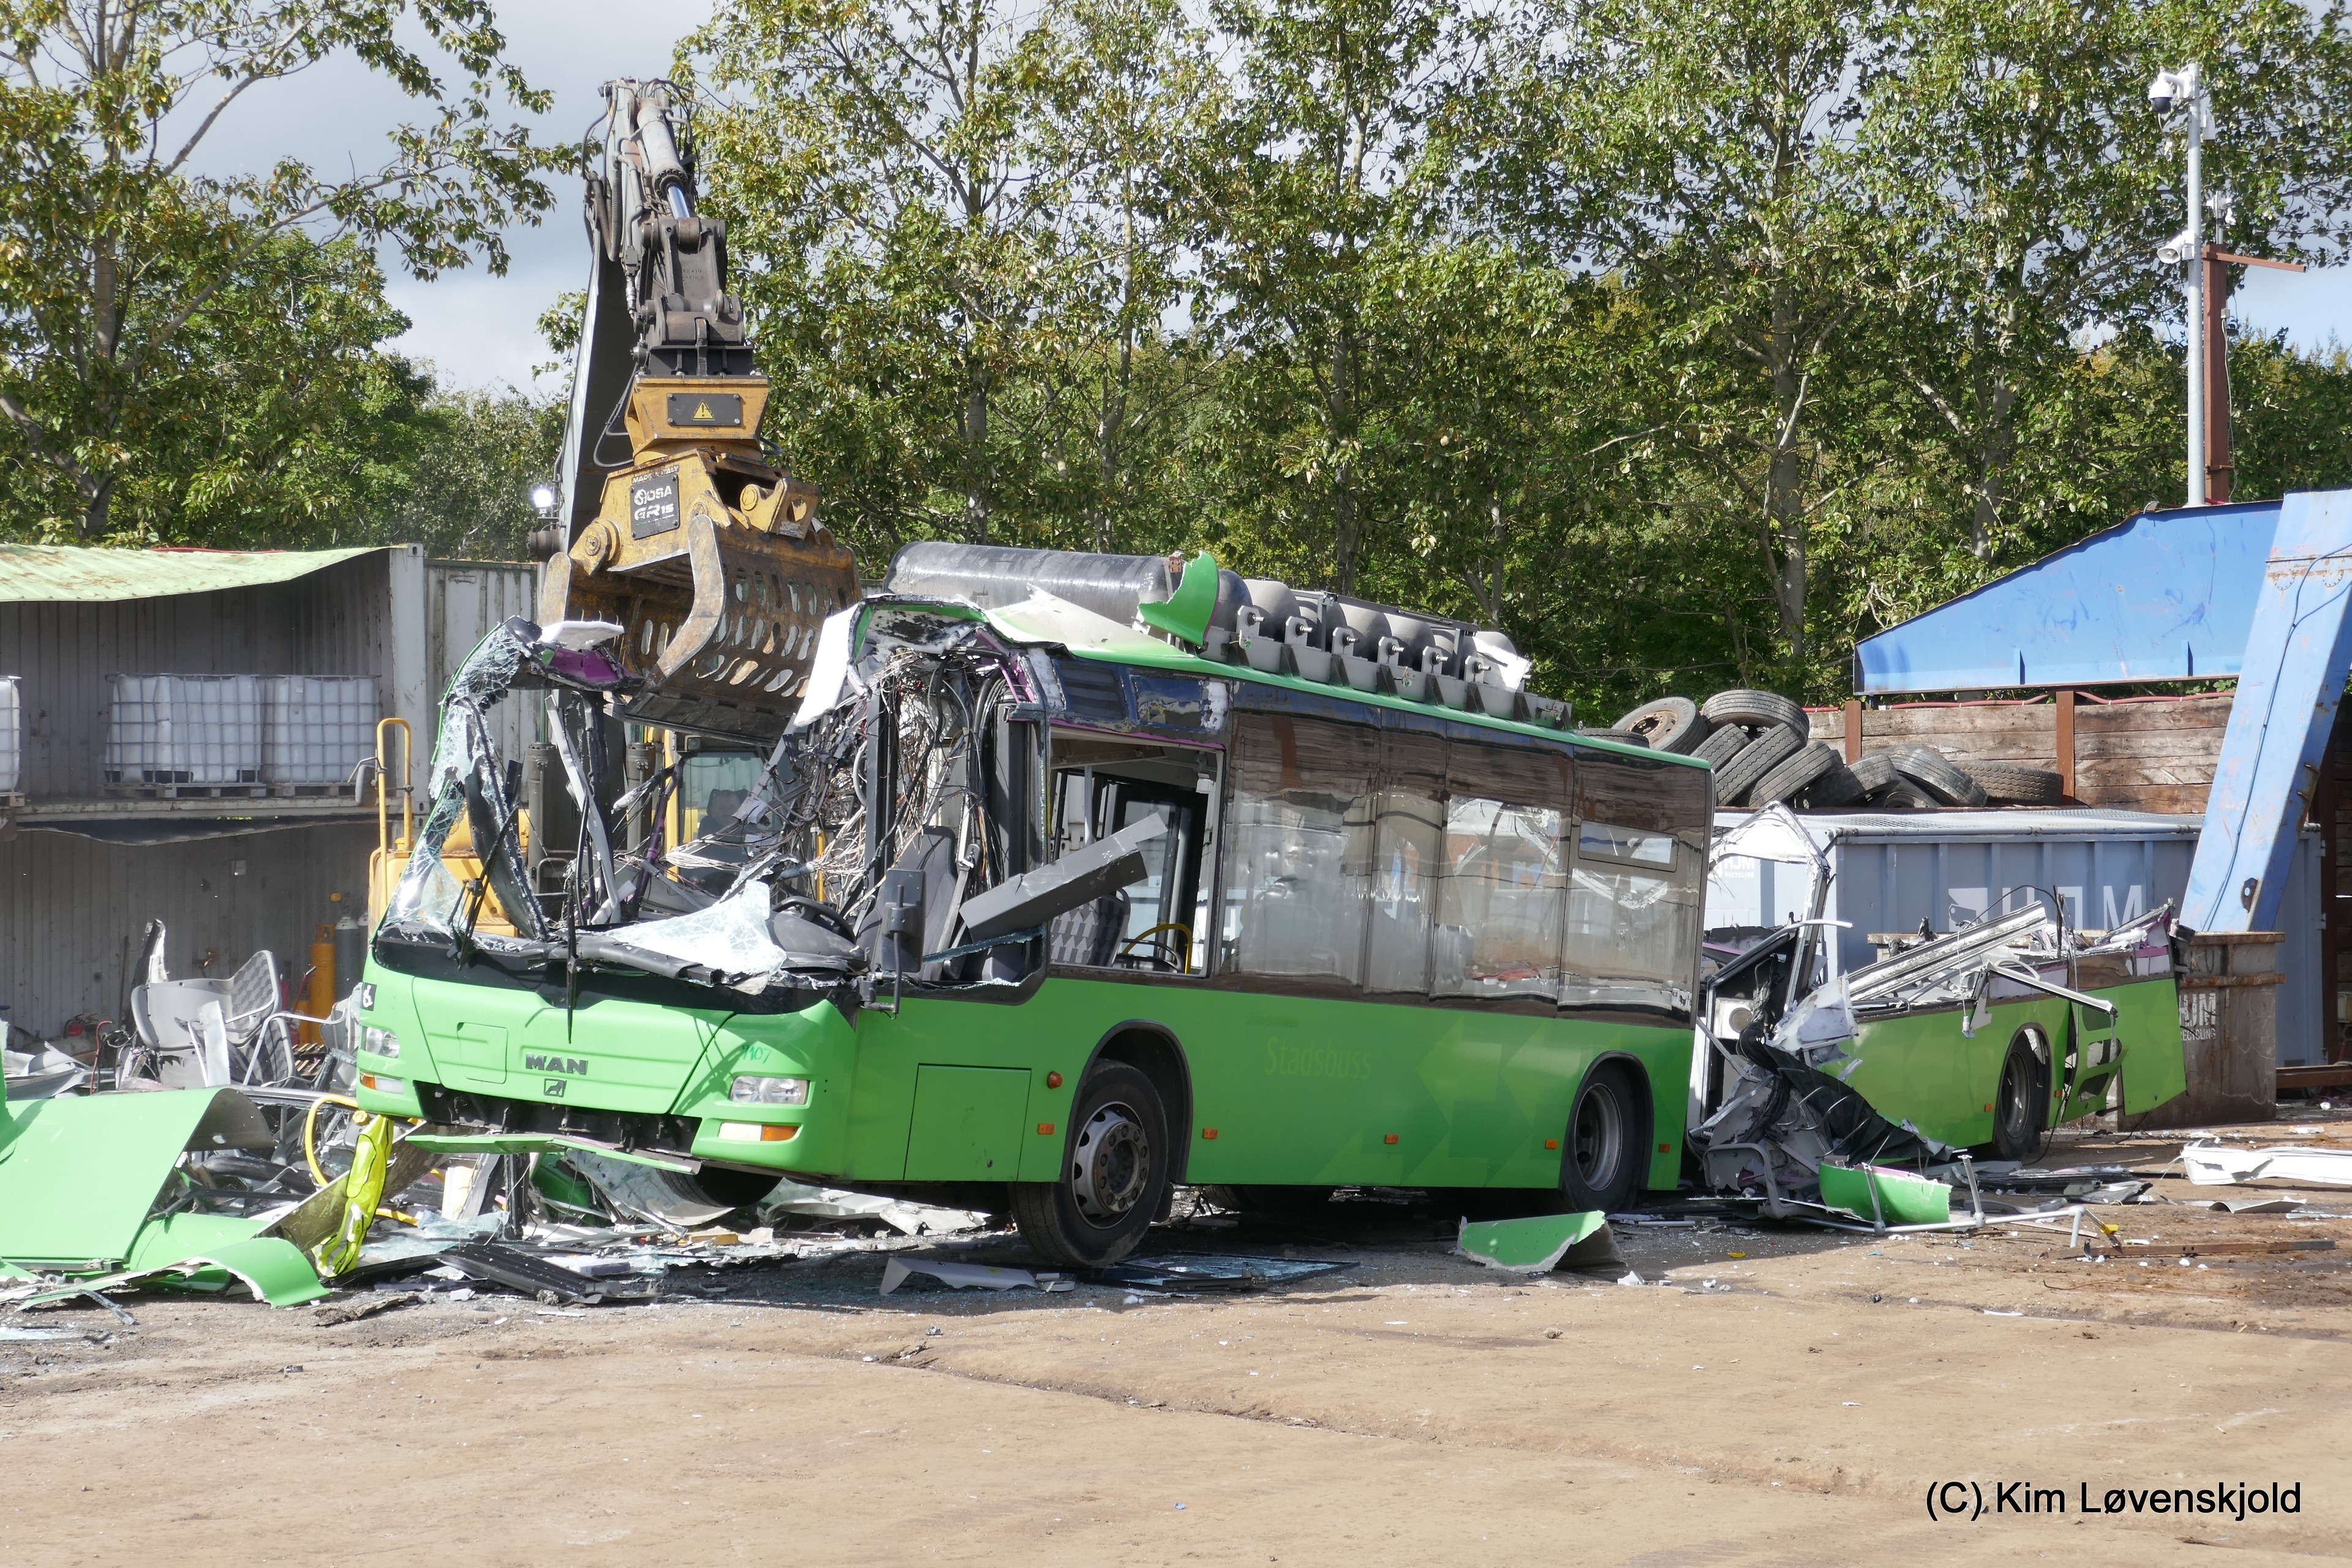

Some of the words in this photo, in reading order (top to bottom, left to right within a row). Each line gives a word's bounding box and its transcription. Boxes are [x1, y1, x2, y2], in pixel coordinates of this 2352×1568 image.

[2180, 1028, 2217, 1041] ECYCLING
[526, 1054, 588, 1075] MAN
[1264, 1036, 1372, 1080] Stadsbuss
